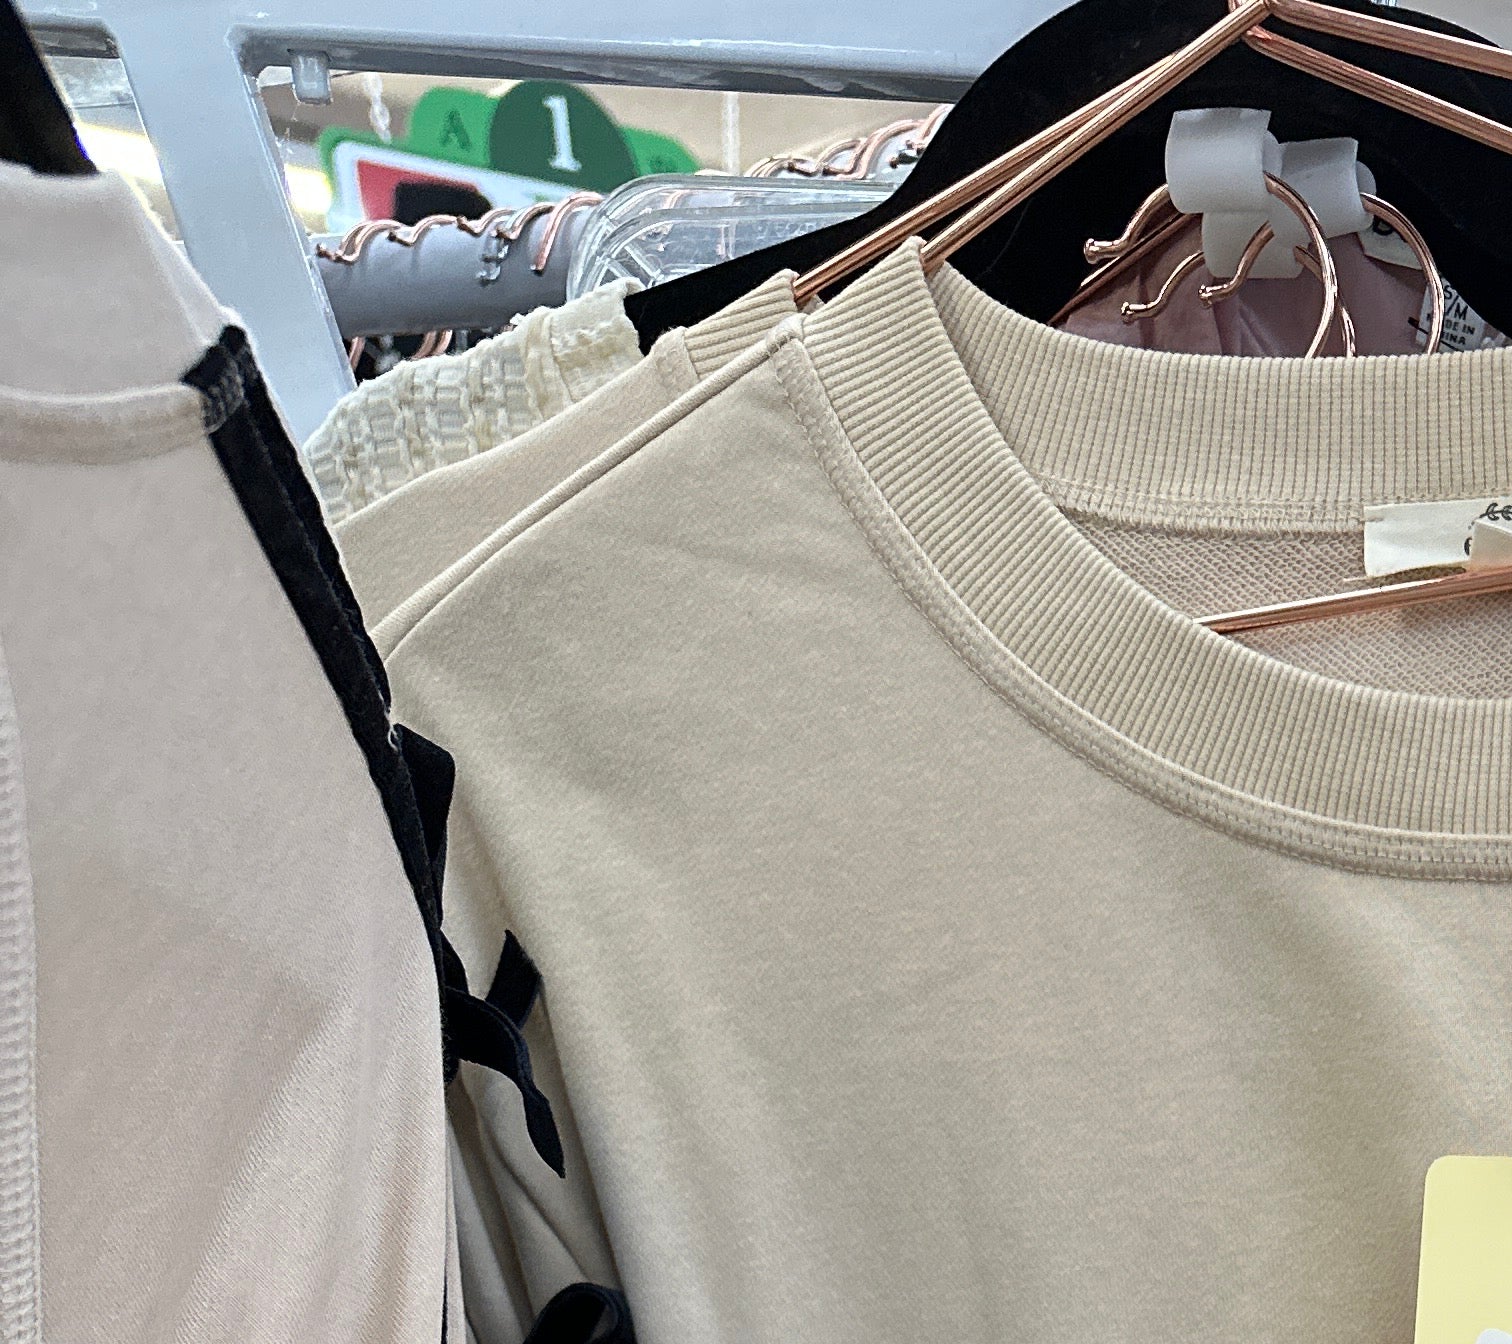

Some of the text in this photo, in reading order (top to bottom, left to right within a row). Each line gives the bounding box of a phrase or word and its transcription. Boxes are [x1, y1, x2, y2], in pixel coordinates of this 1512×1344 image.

[439, 110, 473, 152] A
[541, 95, 582, 173] 1
[1461, 323, 1476, 335] IN
